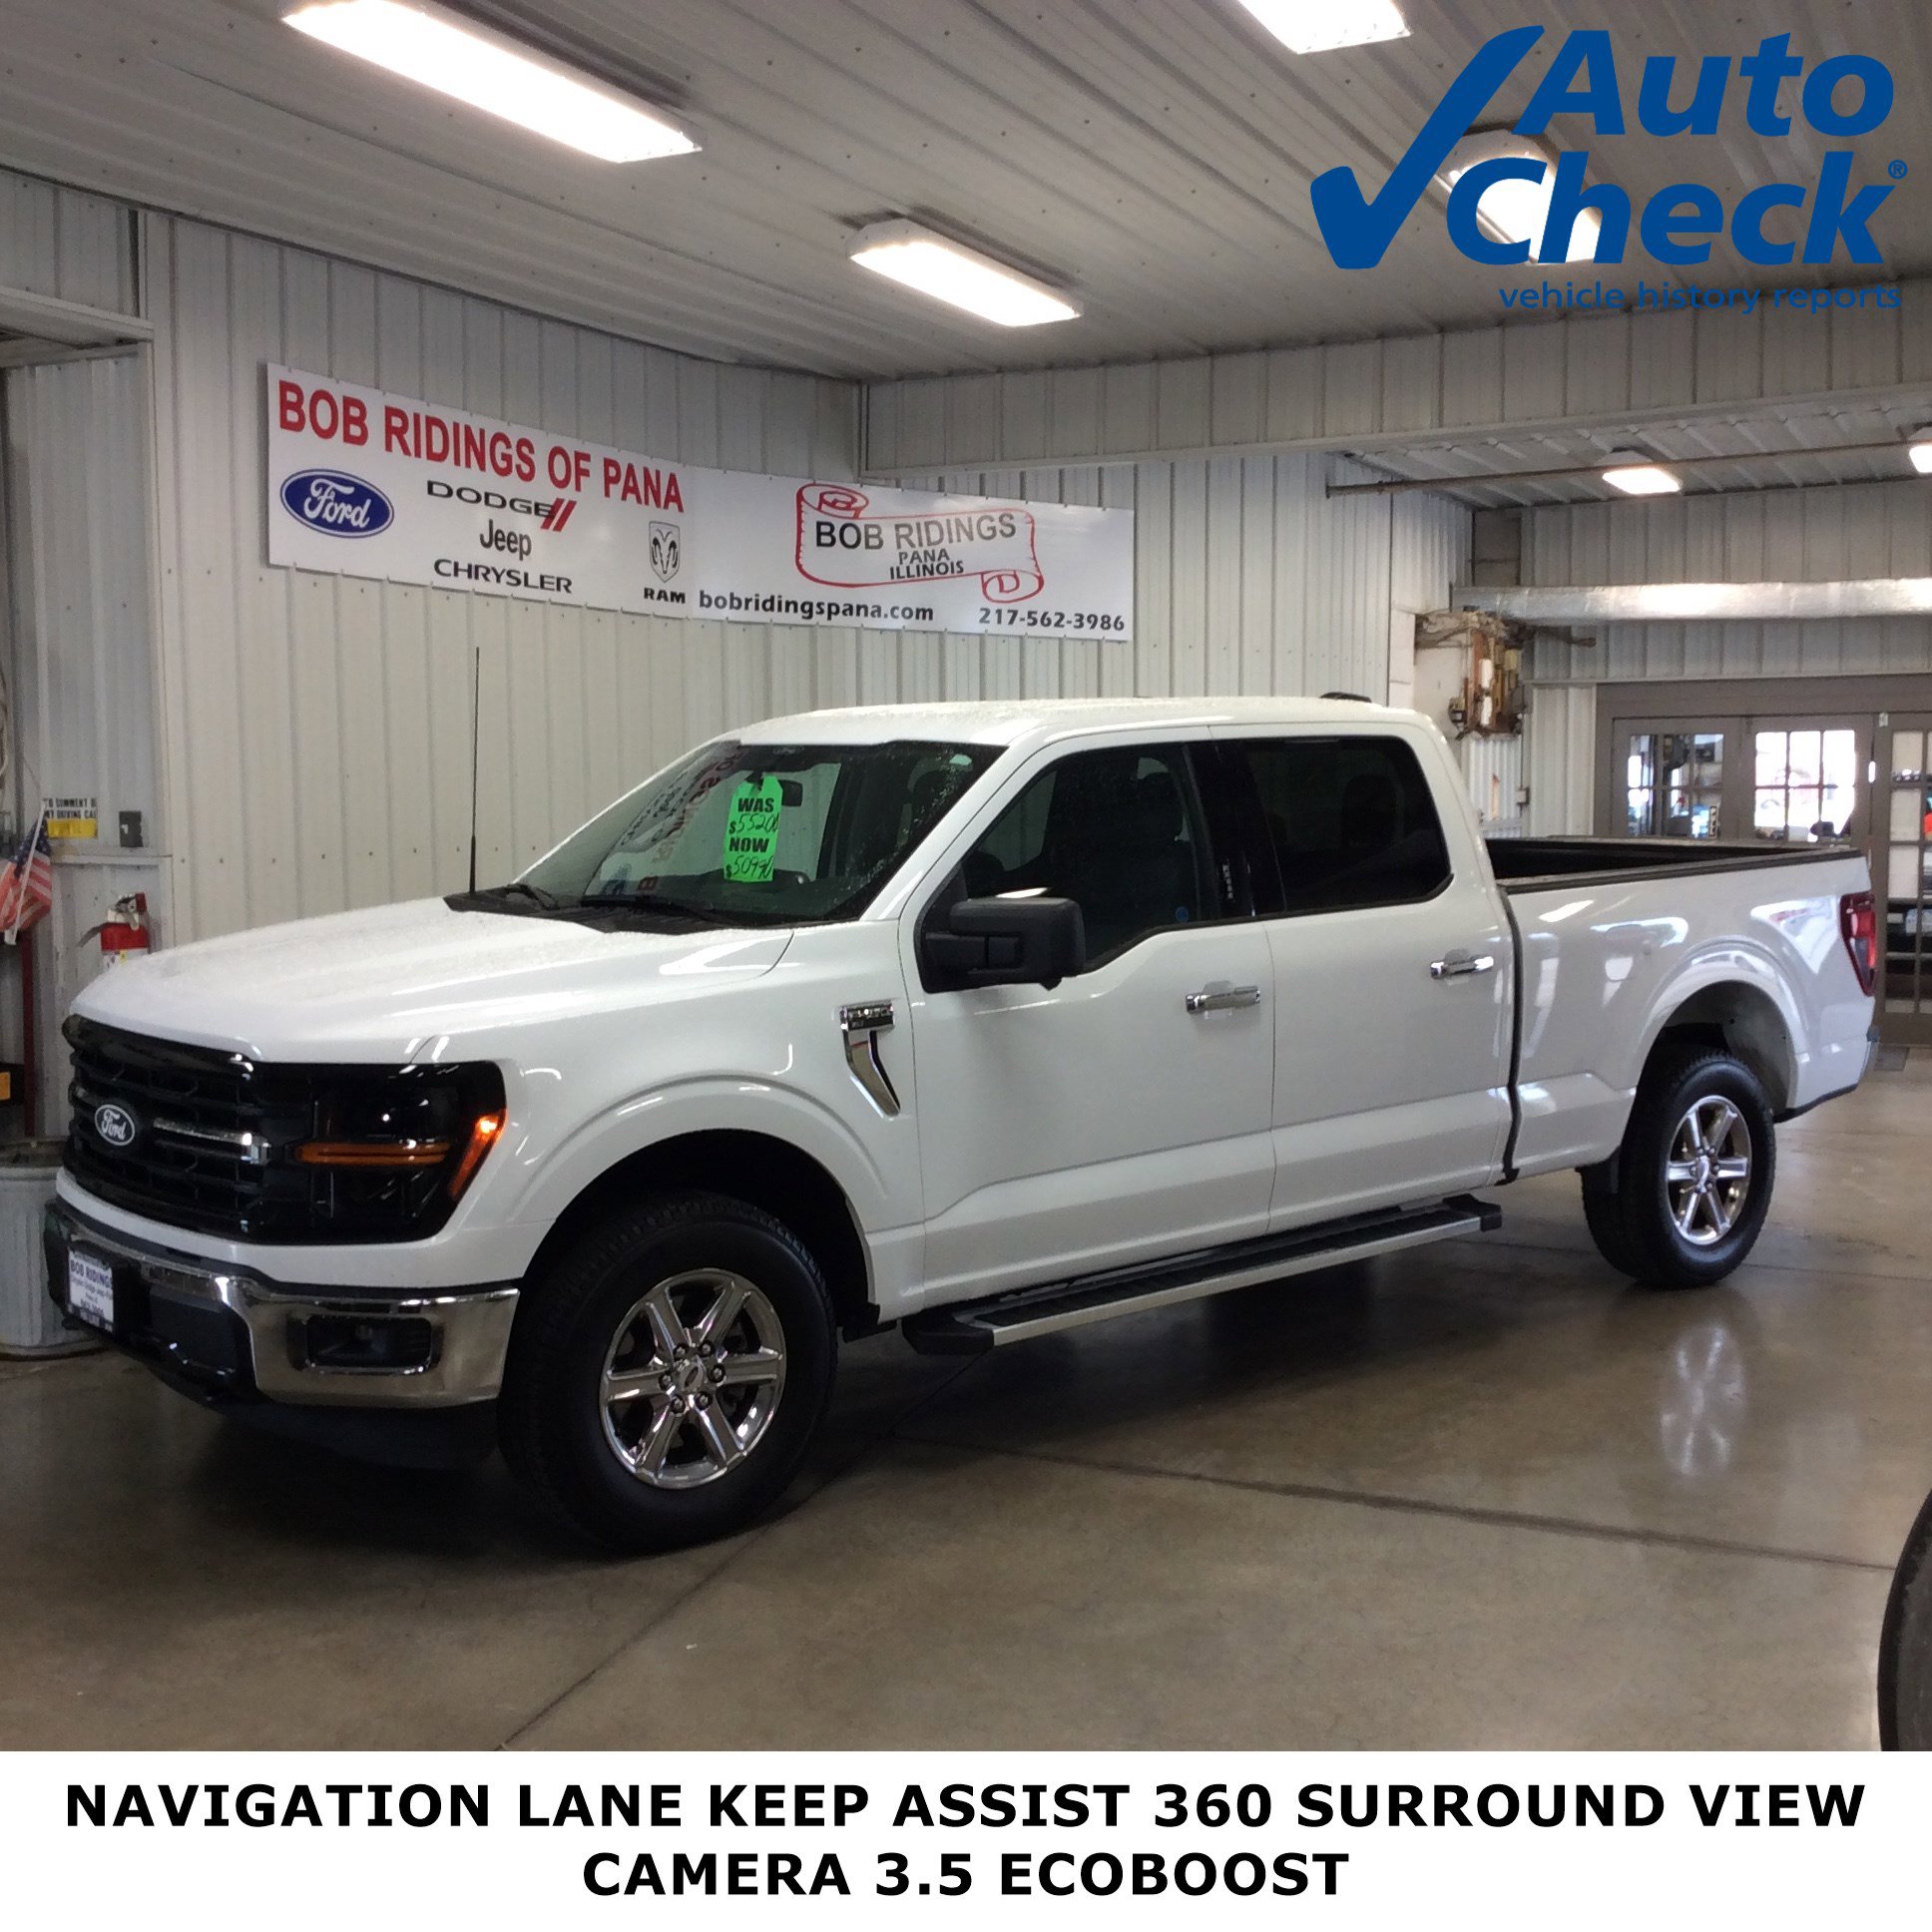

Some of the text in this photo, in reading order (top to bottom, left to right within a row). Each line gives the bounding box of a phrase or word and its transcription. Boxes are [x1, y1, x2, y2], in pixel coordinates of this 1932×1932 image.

[278, 380, 685, 512] BOB RIDINGS OF PANA
[303, 478, 372, 528] Ford
[427, 479, 556, 520] DODGE
[479, 519, 532, 561] Jeep
[816, 513, 1016, 550] BOB RIDINGS
[889, 560, 964, 580] ILLINOIS
[898, 548, 950, 565] PANA
[433, 559, 572, 593] CHRYSLER
[644, 588, 686, 605] RAM
[700, 590, 934, 622] bobridingspana.com
[979, 608, 1125, 632] 217-562-3986
[737, 797, 774, 813] WAS
[728, 837, 770, 853] NOW
[101, 1109, 127, 1140] Ford
[70, 1259, 84, 1276] BOB
